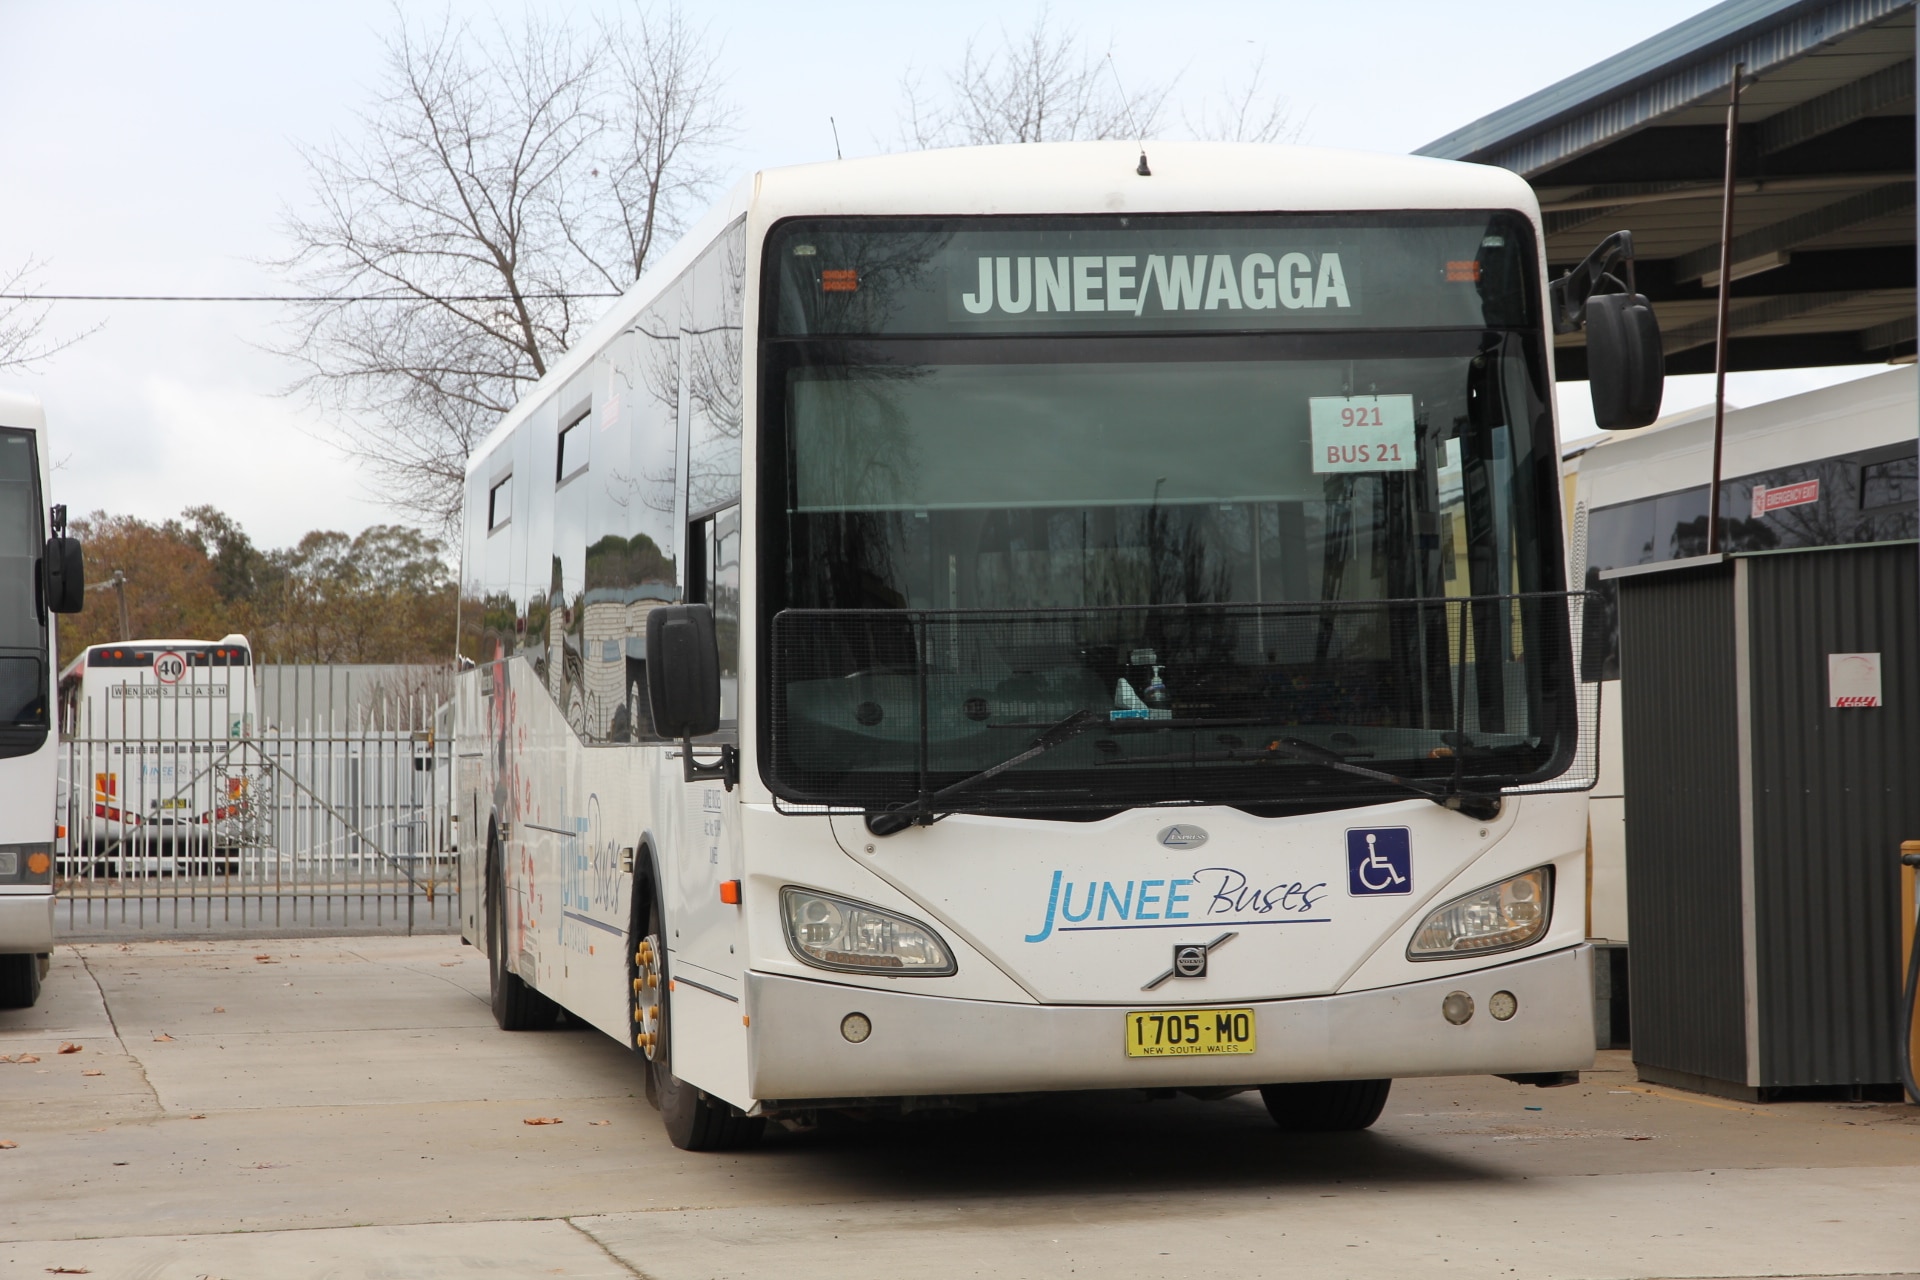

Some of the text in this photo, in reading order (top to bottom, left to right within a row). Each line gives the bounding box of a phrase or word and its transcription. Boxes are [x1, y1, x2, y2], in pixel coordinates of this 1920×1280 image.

[962, 251, 1351, 317] JUNEE/WAGGA
[1341, 407, 1383, 427] 921
[1327, 444, 1402, 463] BUS 21
[160, 660, 182, 676] 40
[141, 687, 168, 696] LIGHS
[557, 786, 589, 946] JUNEE
[1024, 867, 1328, 944] JUNEE Buses
[1178, 957, 1205, 966] VOLVO
[1143, 1044, 1239, 1055] NEW SOUTH WALES
